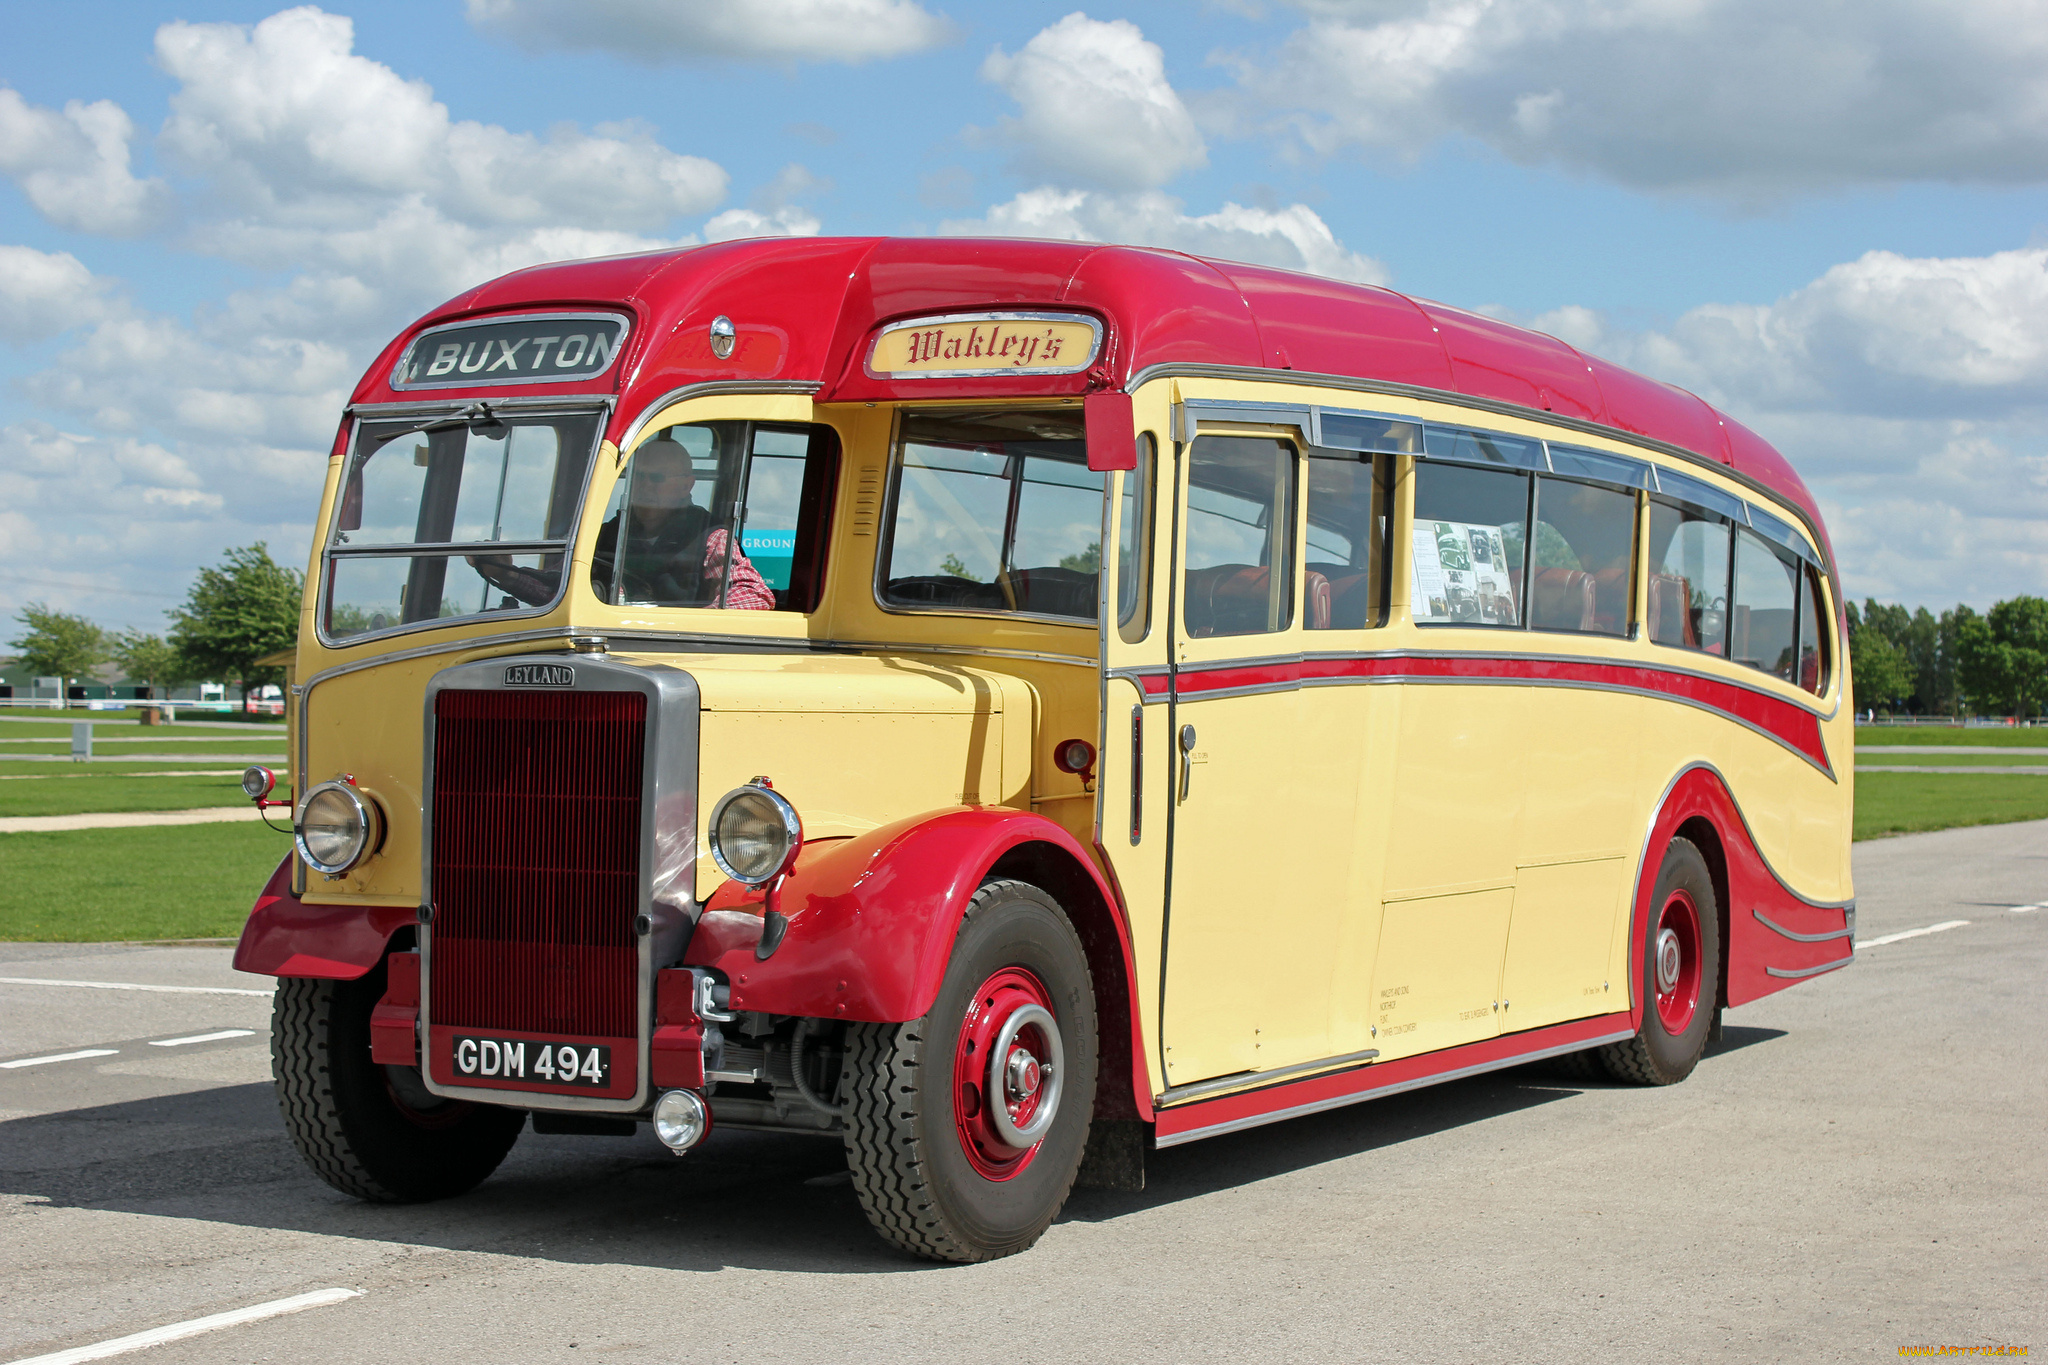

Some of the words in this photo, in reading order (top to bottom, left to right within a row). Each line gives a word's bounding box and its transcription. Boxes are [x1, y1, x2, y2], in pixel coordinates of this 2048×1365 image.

[426, 331, 618, 377] BUXTON
[905, 325, 1065, 366] Wakley's
[742, 538, 796, 548] GROUN
[506, 665, 572, 684] LEYLAND
[458, 1038, 525, 1078] GDM
[534, 1044, 603, 1083] 494
